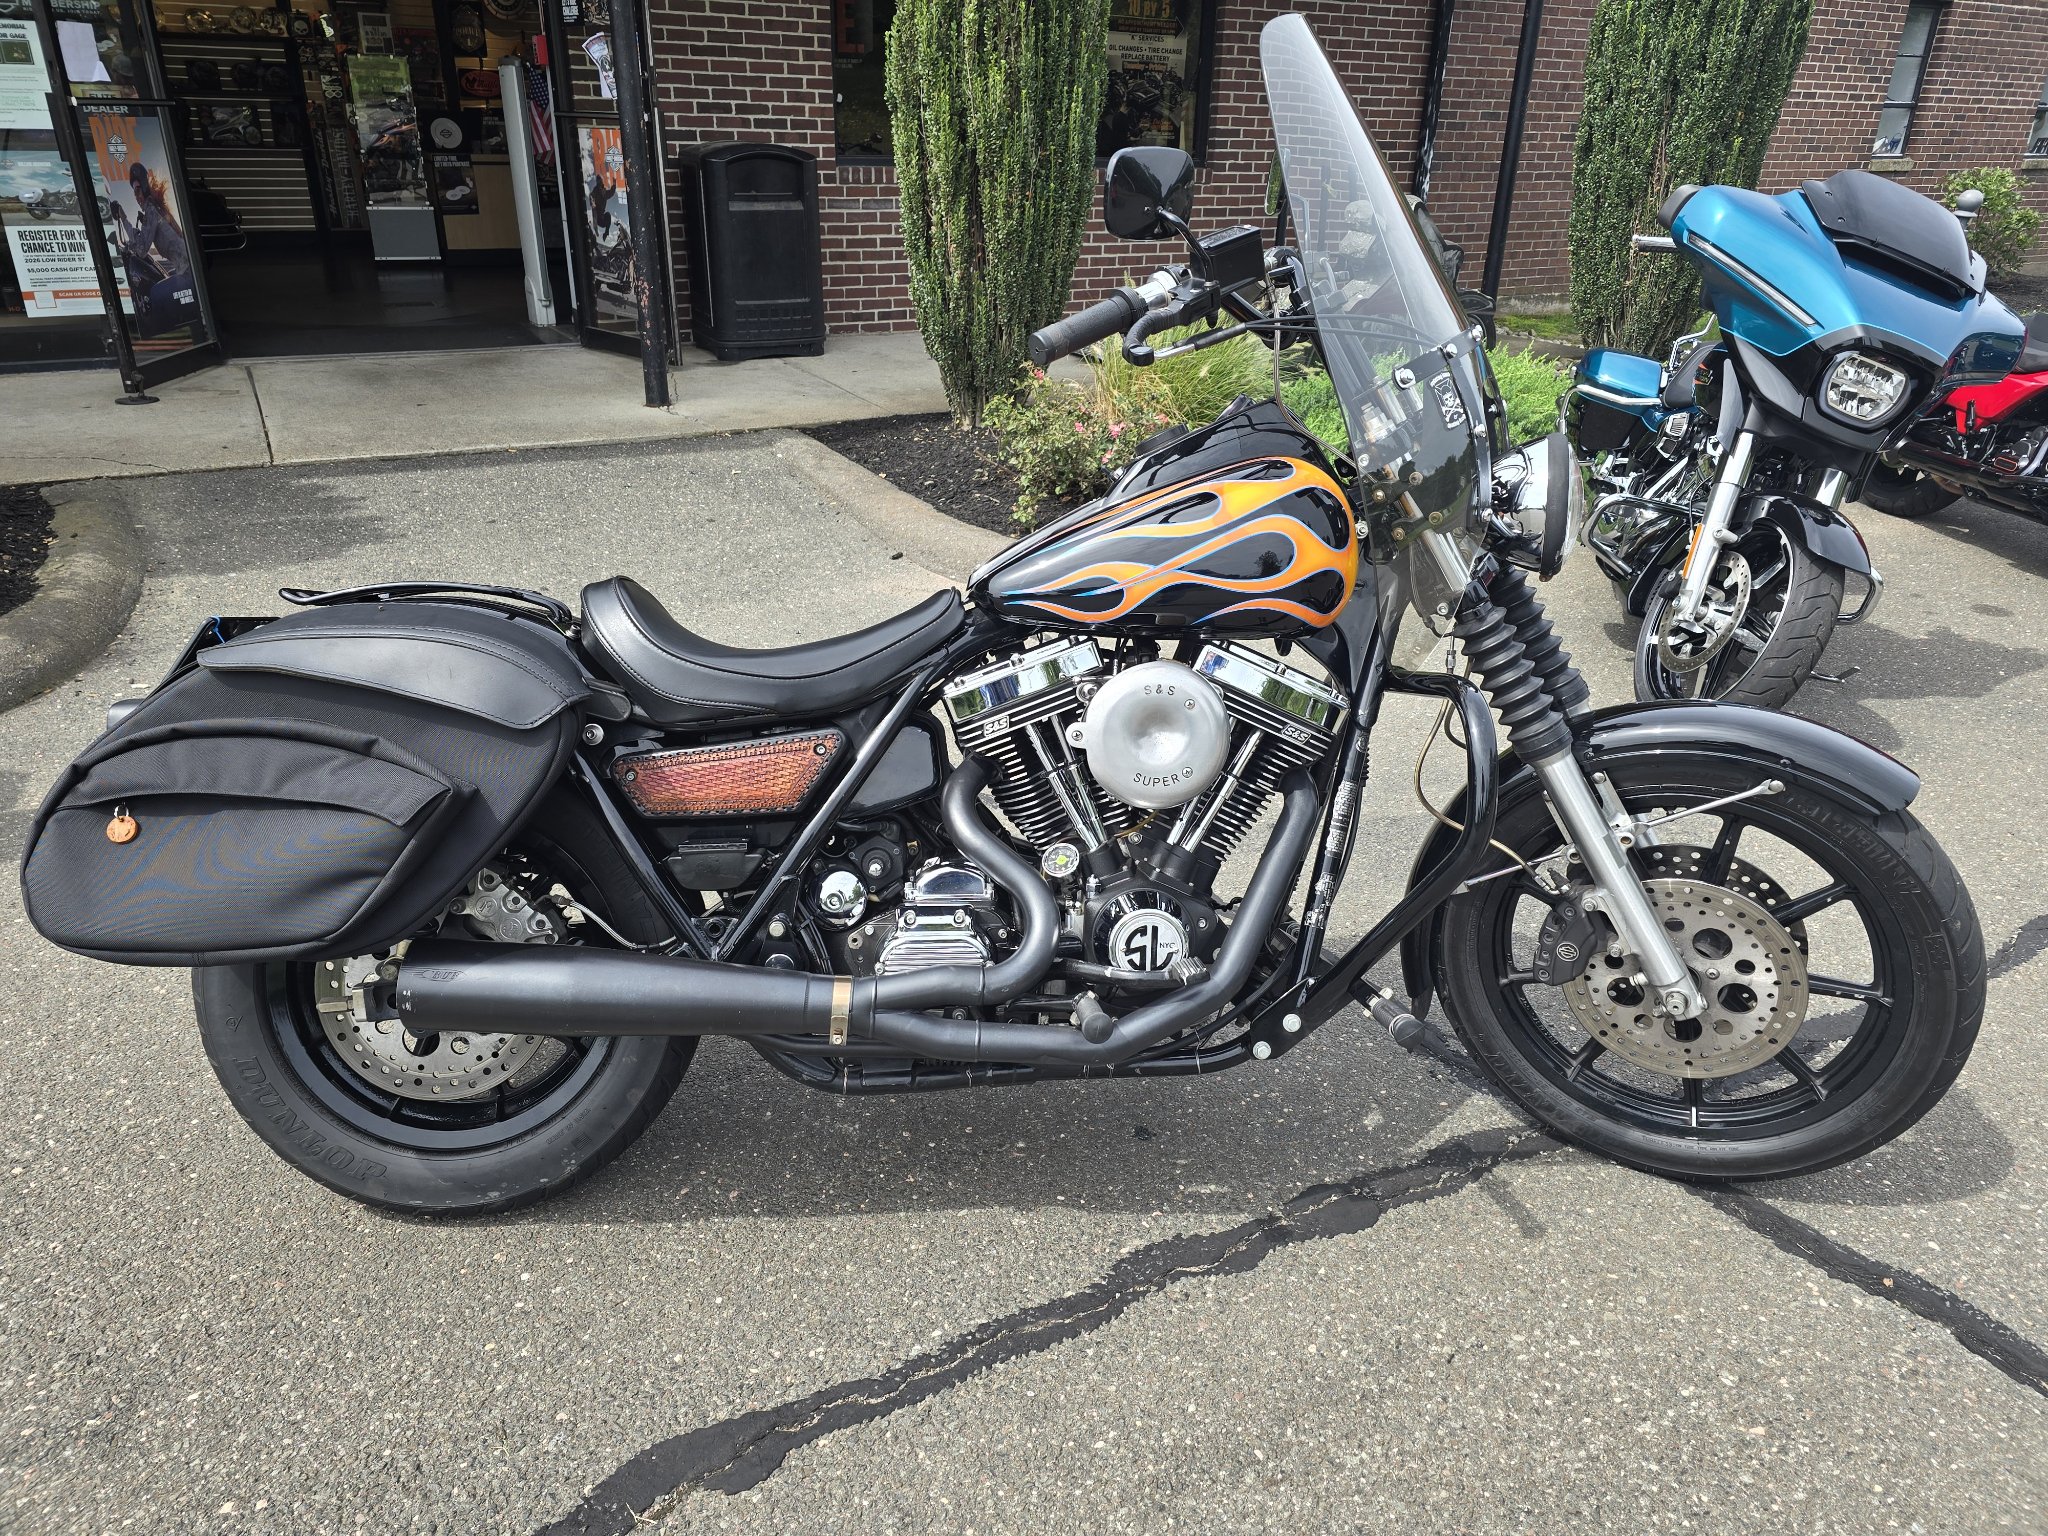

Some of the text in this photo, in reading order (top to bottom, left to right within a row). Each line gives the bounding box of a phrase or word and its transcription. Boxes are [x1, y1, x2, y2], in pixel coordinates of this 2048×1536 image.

[22, 0, 101, 9] MBERSHIP
[1118, 45, 1144, 53] CHANGES
[1147, 46, 1160, 54] TIRE
[1120, 53, 1171, 62] REPLACE BATTERY
[82, 105, 129, 114] DEALER
[17, 230, 58, 242] REGISTER
[60, 229, 77, 241] FOR
[21, 242, 86, 254] CHANCE TO WIN
[985, 717, 1008, 736] S&S
[1284, 726, 1309, 742] S&S
[1133, 772, 1181, 784] SUPER
[231, 1054, 389, 1182] DUNLOP
